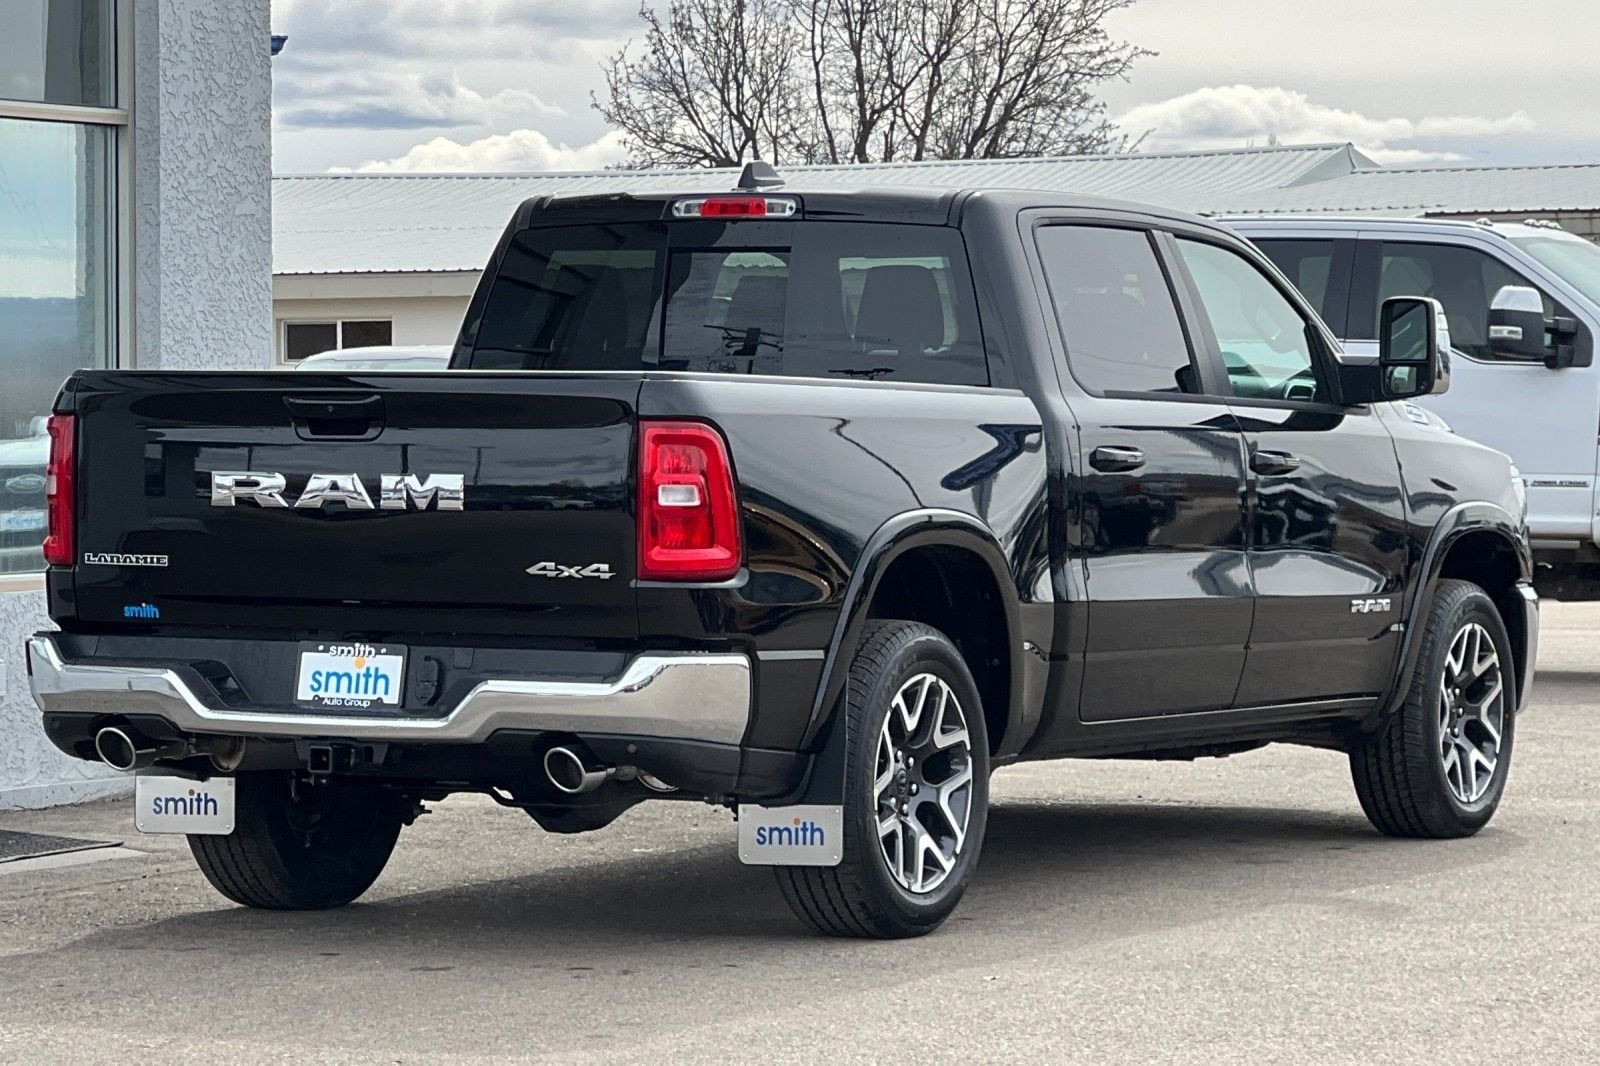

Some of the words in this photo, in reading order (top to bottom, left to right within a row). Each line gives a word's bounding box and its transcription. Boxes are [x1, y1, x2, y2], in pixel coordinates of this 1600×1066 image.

[211, 471, 464, 511] RAM
[84, 552, 168, 567] LARAMIE
[525, 562, 616, 579] 4x4
[124, 602, 159, 619] smith
[329, 643, 376, 657] smith
[310, 656, 389, 696] smith
[322, 698, 342, 706] Auto
[344, 699, 371, 708] Group
[153, 789, 218, 816] smith
[756, 818, 825, 846] smith
